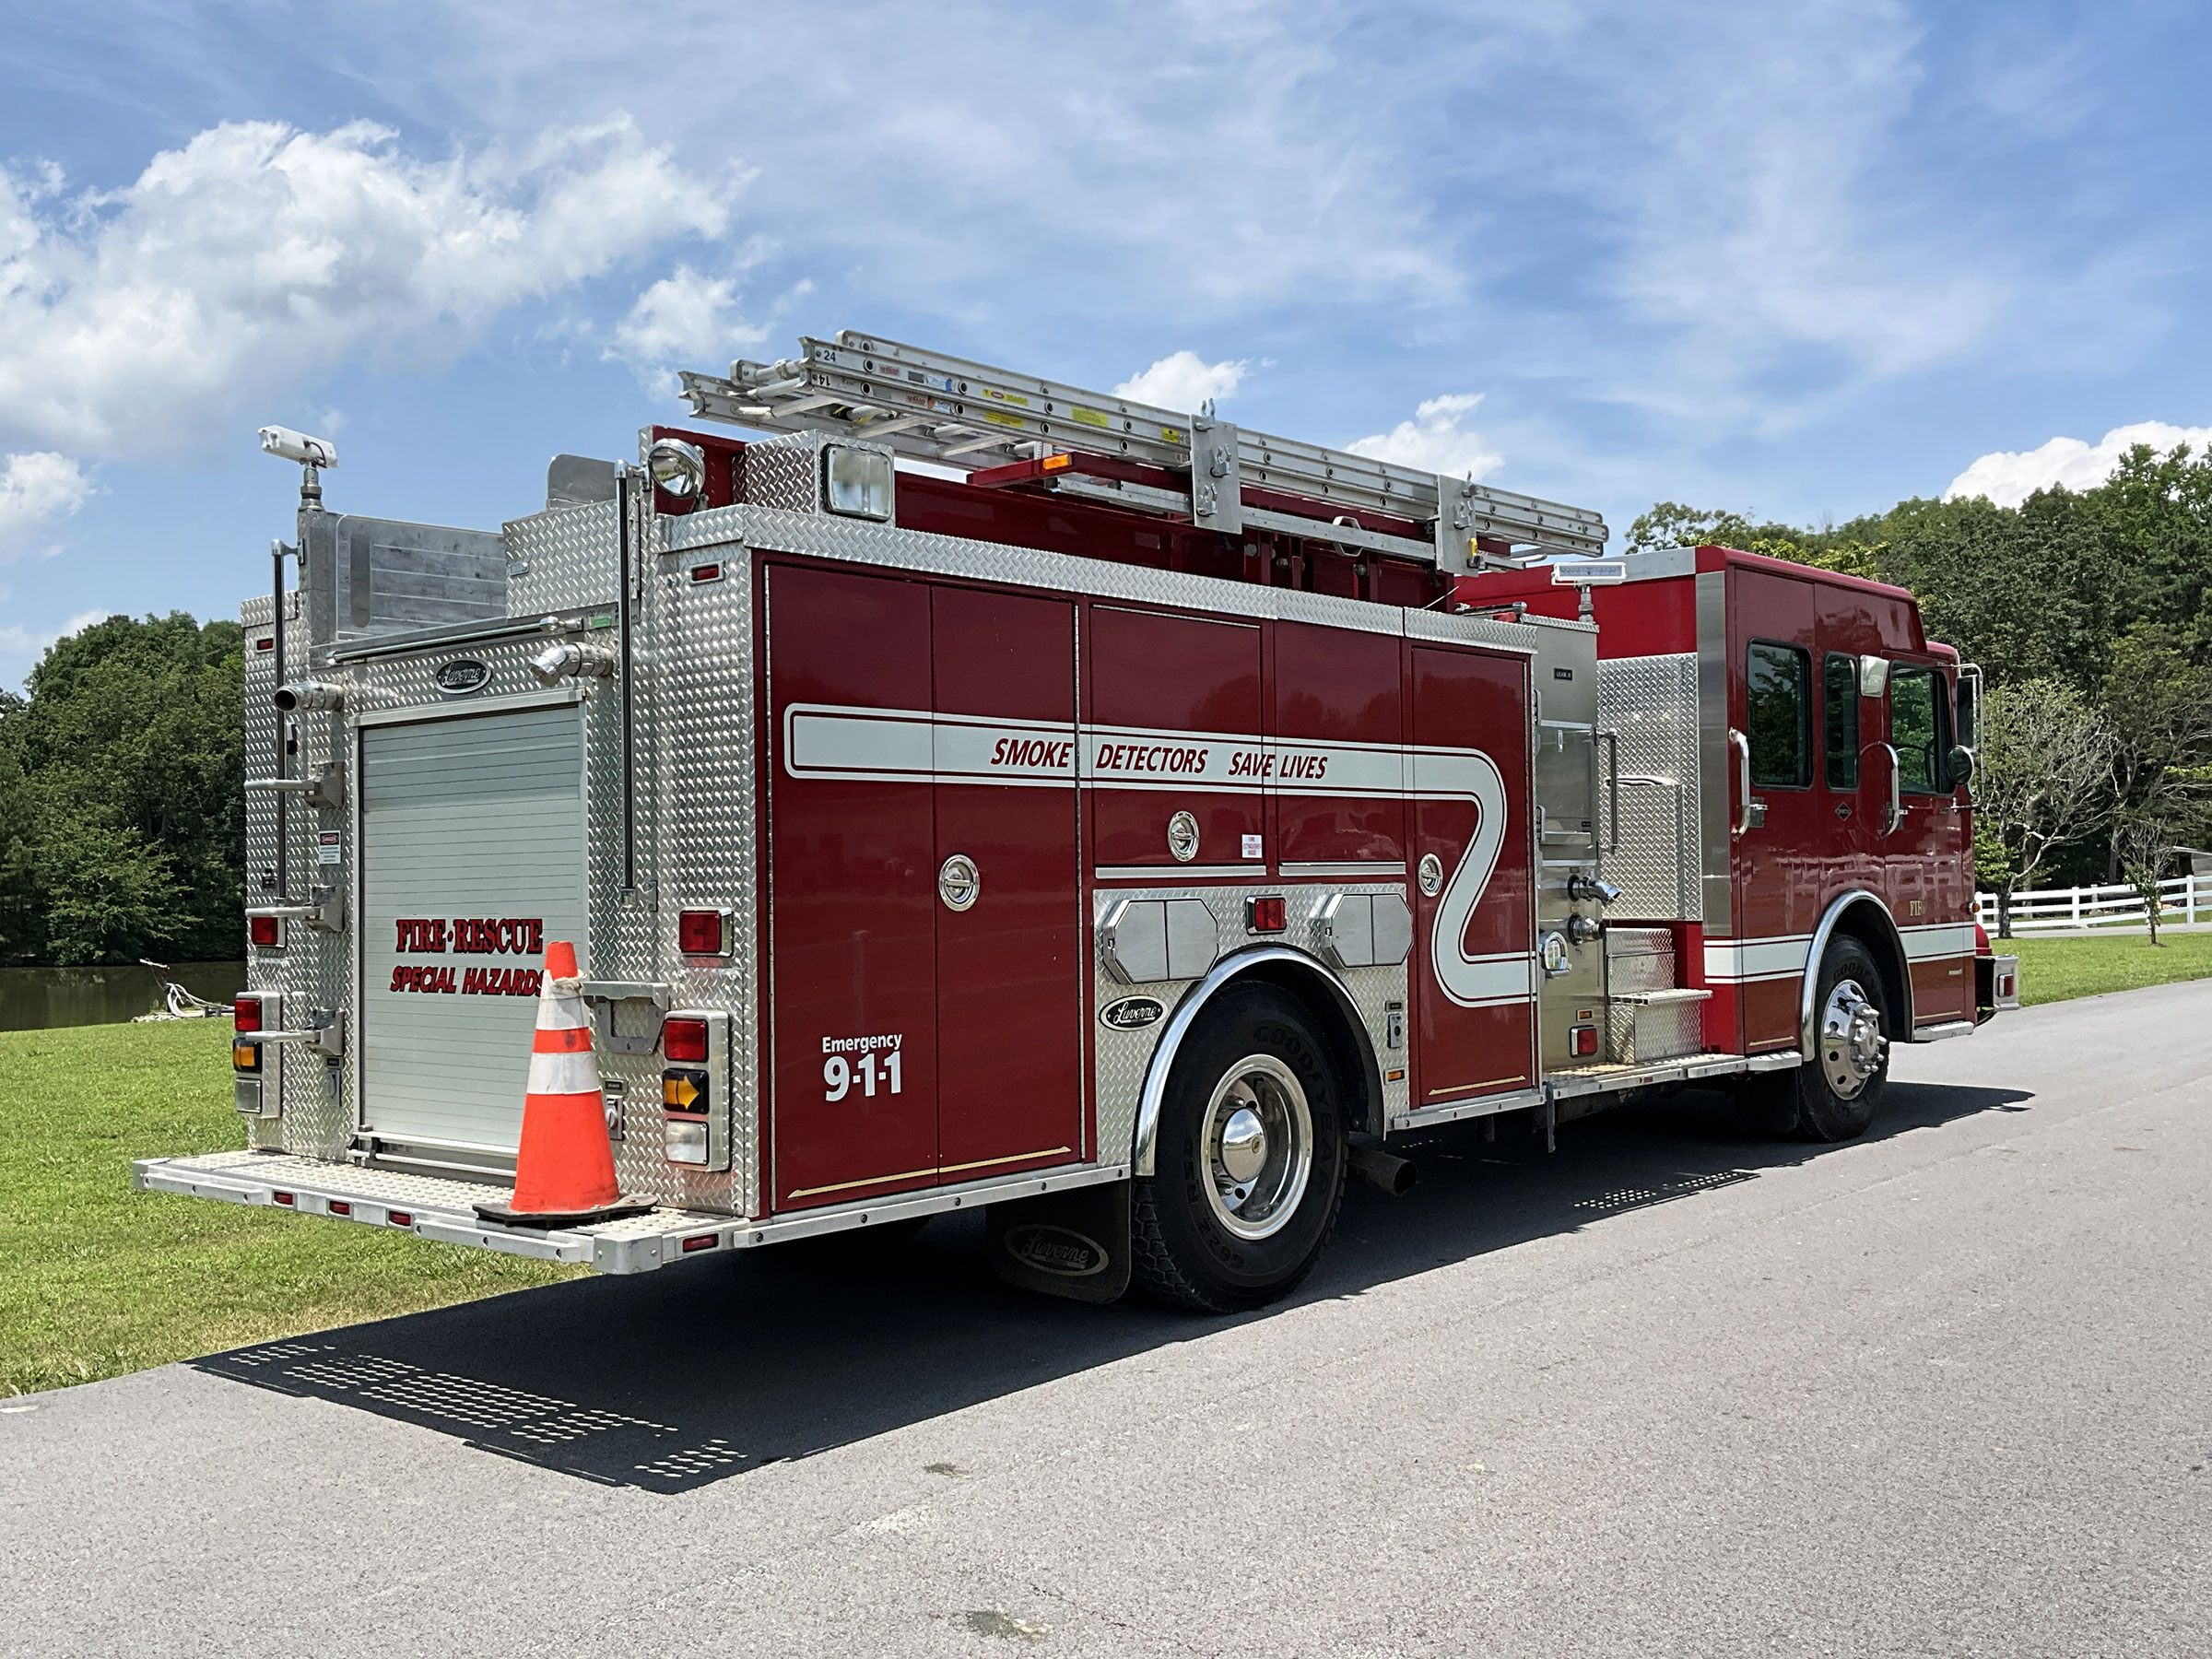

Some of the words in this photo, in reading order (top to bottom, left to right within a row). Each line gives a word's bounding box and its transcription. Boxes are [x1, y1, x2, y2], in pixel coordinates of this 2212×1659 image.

[824, 349, 836, 362] 24
[818, 374, 830, 386] 14
[991, 738, 1074, 768] SMOKE
[1095, 743, 1208, 774] DETECTORS
[1228, 751, 1276, 778] SAVE
[1279, 755, 1328, 779] LIVES
[390, 966, 457, 994] SPECIAL
[1113, 1001, 1158, 1024] Luverne
[822, 1034, 902, 1053] Emergency
[1021, 1230, 1088, 1268] Luverne
